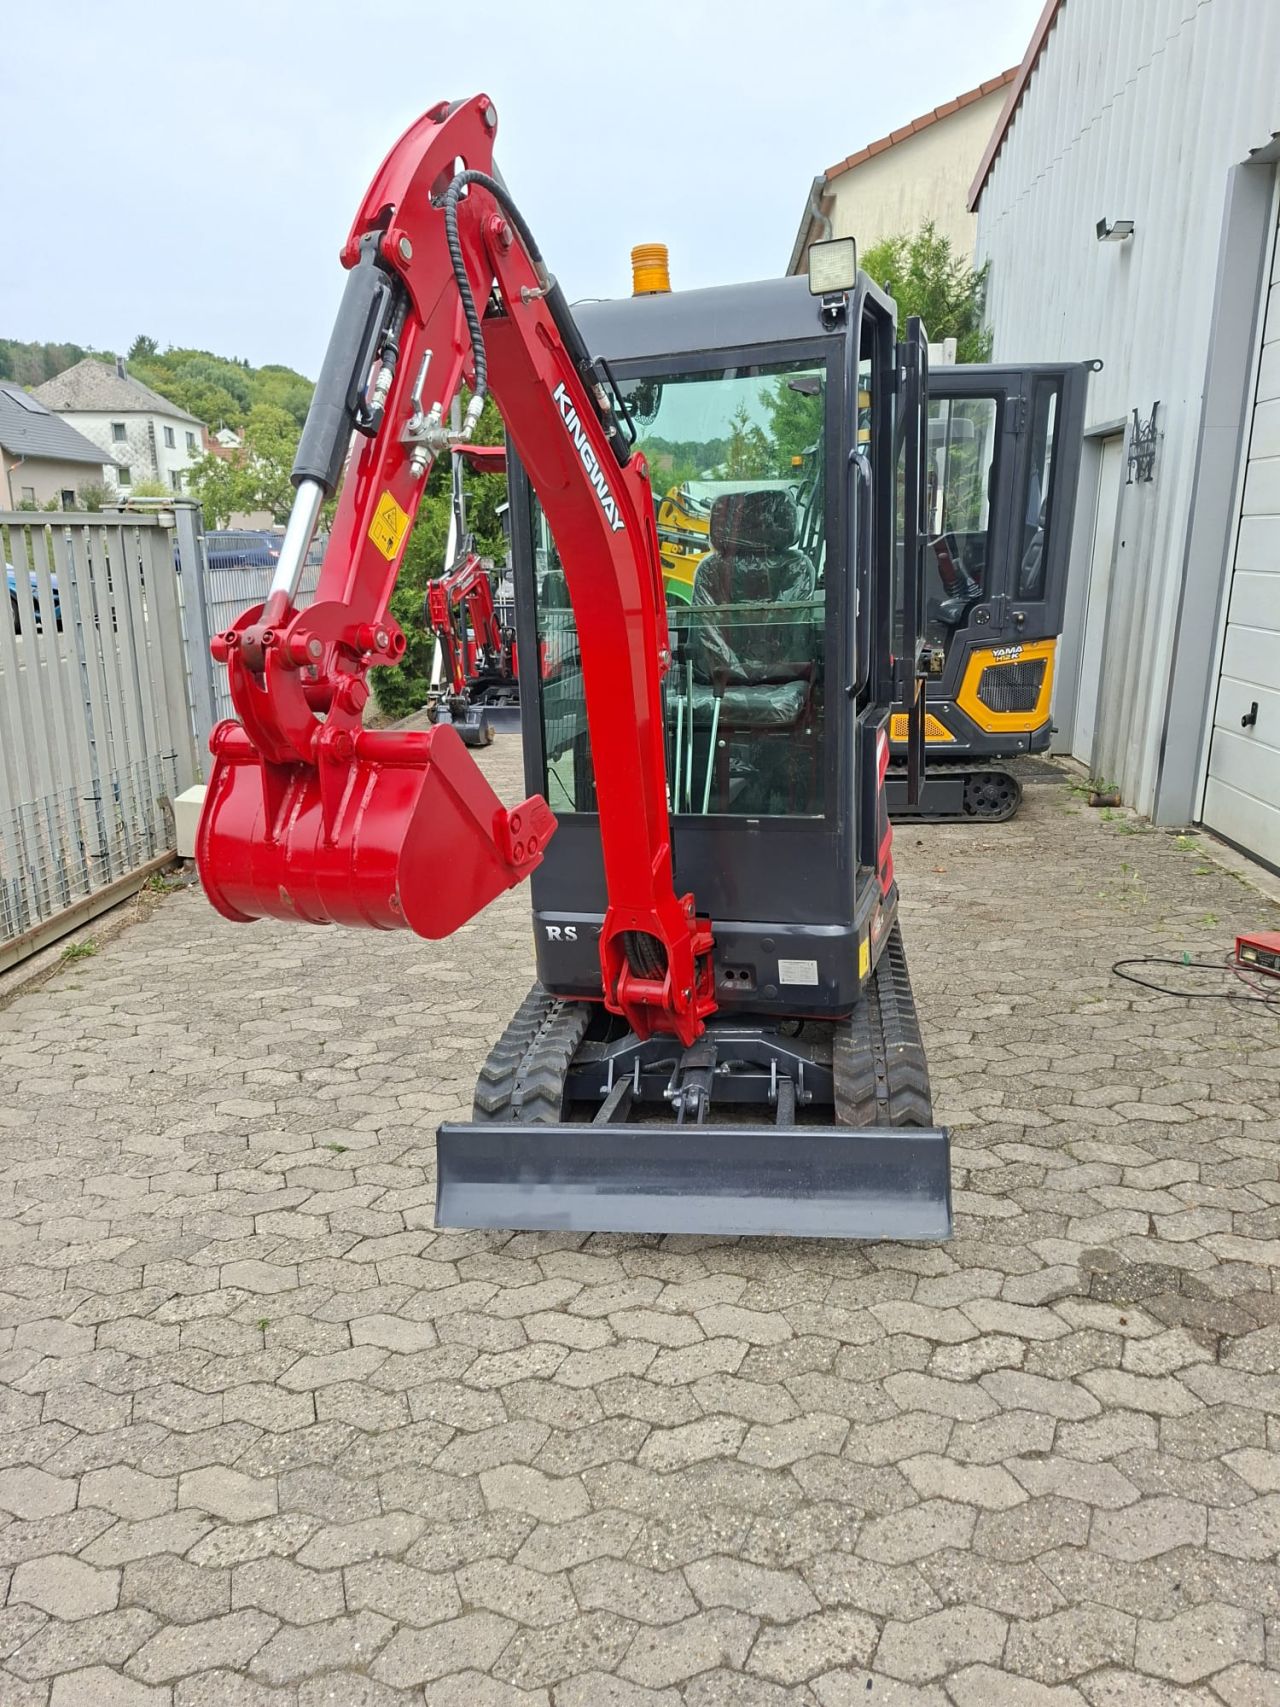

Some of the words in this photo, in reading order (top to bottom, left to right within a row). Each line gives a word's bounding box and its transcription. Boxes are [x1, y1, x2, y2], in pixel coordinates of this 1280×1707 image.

[553, 381, 625, 532] KINGWAY
[992, 645, 1023, 657] YAMA
[545, 925, 578, 941] RS
